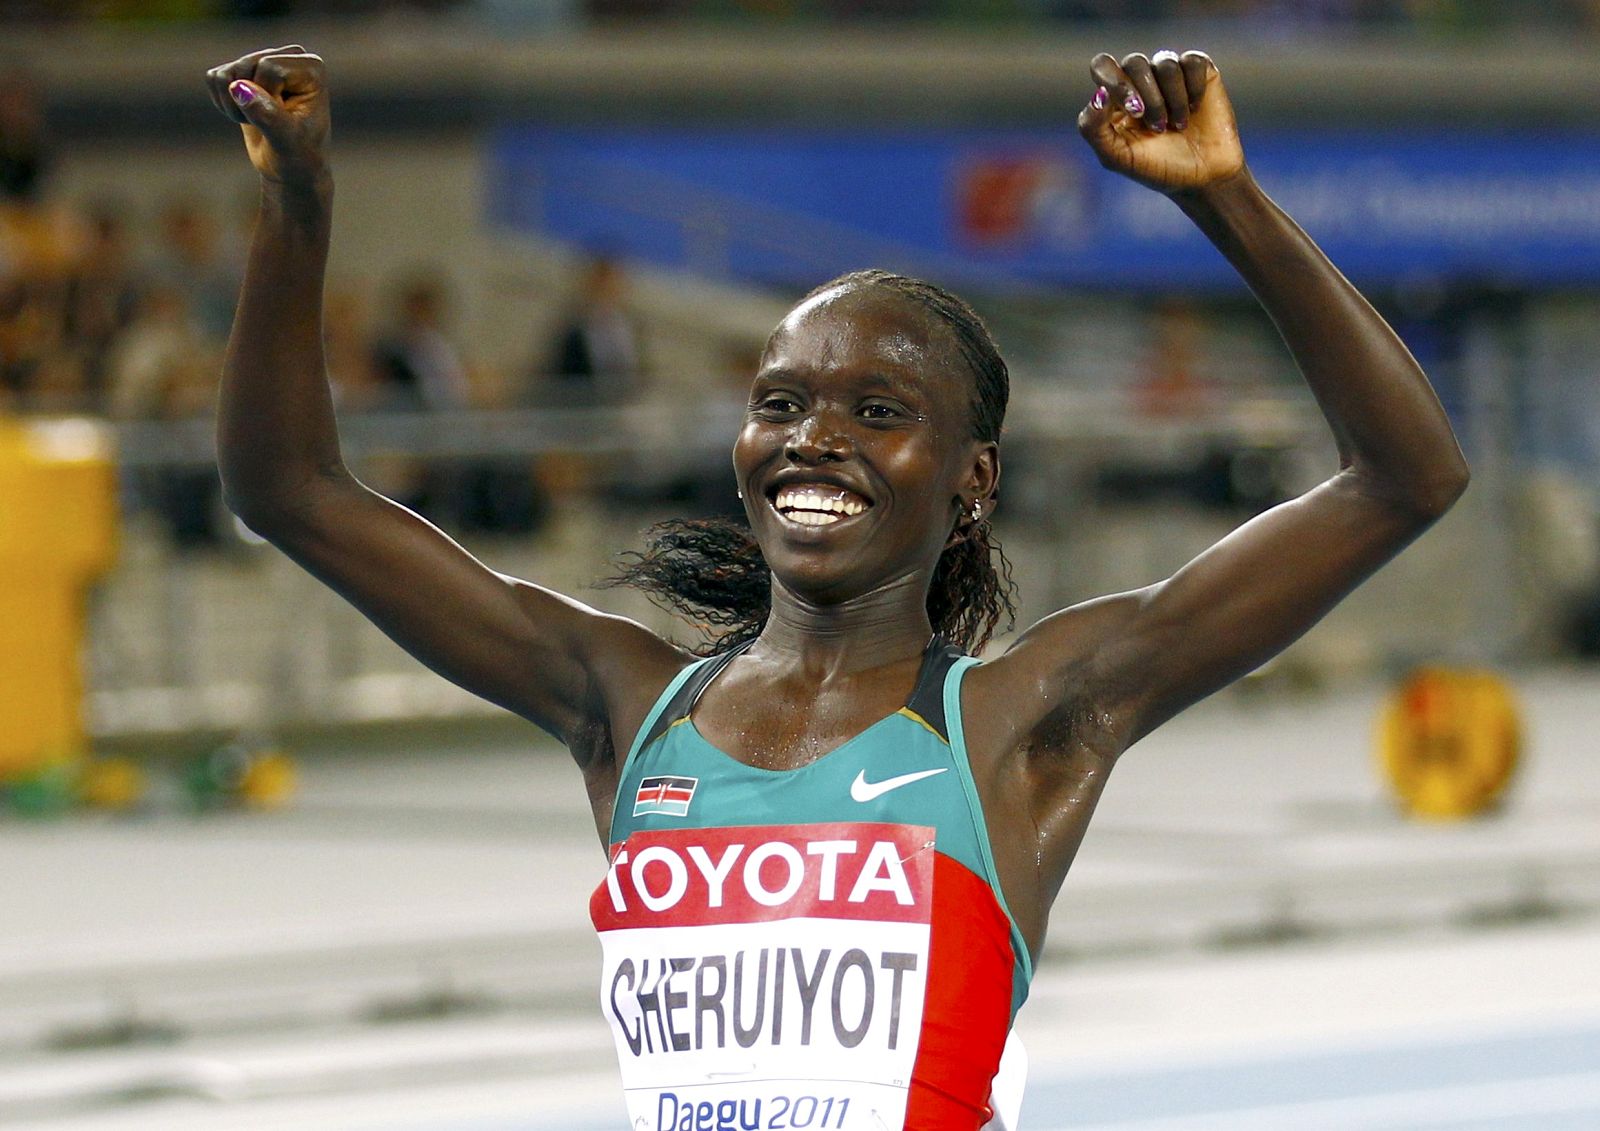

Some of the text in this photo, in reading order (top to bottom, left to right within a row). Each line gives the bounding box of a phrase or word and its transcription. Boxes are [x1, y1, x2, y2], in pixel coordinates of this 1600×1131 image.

[607, 840, 915, 912] TOYOTA
[610, 947, 918, 1057] CHERUIYOT
[657, 1092, 850, 1131] Daegu 2011
